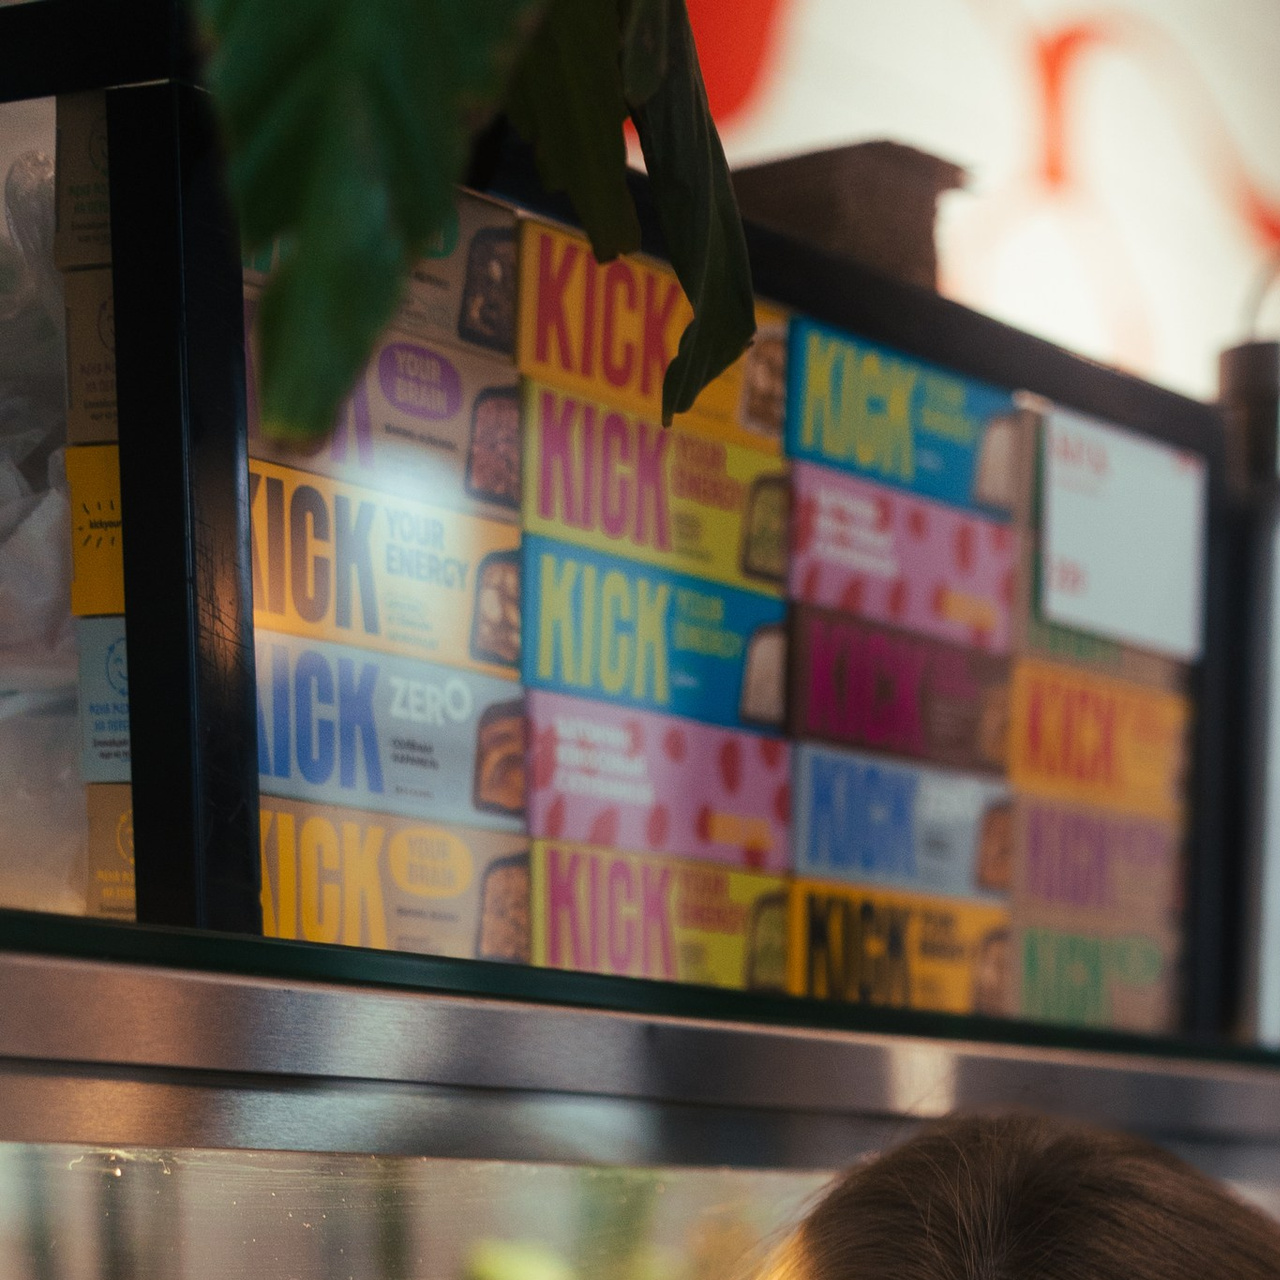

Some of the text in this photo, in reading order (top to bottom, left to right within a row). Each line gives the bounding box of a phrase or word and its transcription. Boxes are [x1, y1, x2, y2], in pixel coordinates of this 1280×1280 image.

[395, 348, 442, 379] YOUR
[535, 233, 682, 397] KICK
[538, 389, 673, 553] KICK
[803, 331, 915, 482] KICK
[384, 507, 446, 549] YOUR
[386, 543, 469, 592] ENERGY
[538, 553, 670, 705] KICK
[256, 644, 385, 794] ICK
[391, 677, 474, 725] ZERO
[809, 752, 921, 879] KICK
[547, 848, 680, 978] KICK
